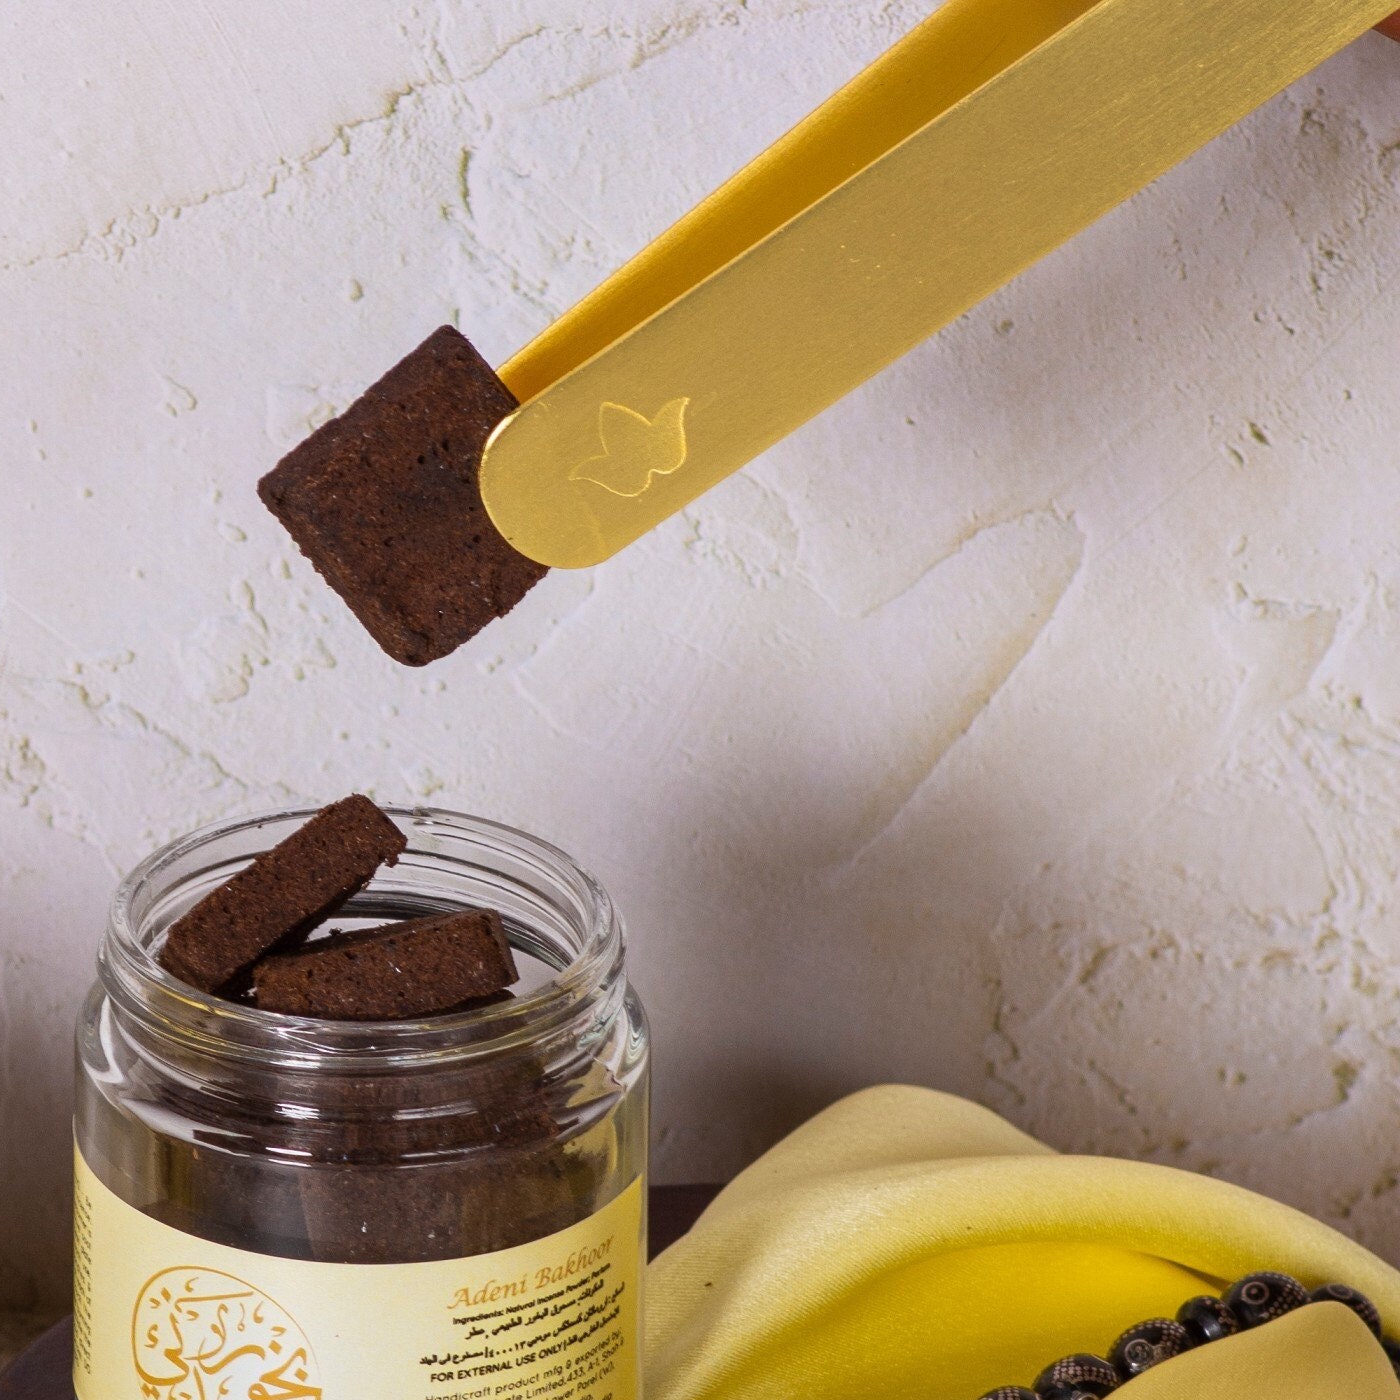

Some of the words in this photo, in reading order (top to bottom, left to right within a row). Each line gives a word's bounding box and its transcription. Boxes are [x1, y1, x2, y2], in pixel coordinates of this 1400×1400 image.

[447, 1273, 527, 1310] Adeni
[535, 1234, 614, 1290] Bakhoor
[506, 1299, 536, 1314] Natural
[537, 1290, 564, 1304] Incense
[430, 1371, 454, 1383] FOR
[457, 1360, 513, 1380] EXTERNAL
[515, 1352, 537, 1367] USE
[495, 1373, 539, 1396] product
[543, 1365, 563, 1380] mfg
[575, 1334, 611, 1366] exported
[577, 1372, 598, 1392] Parel
